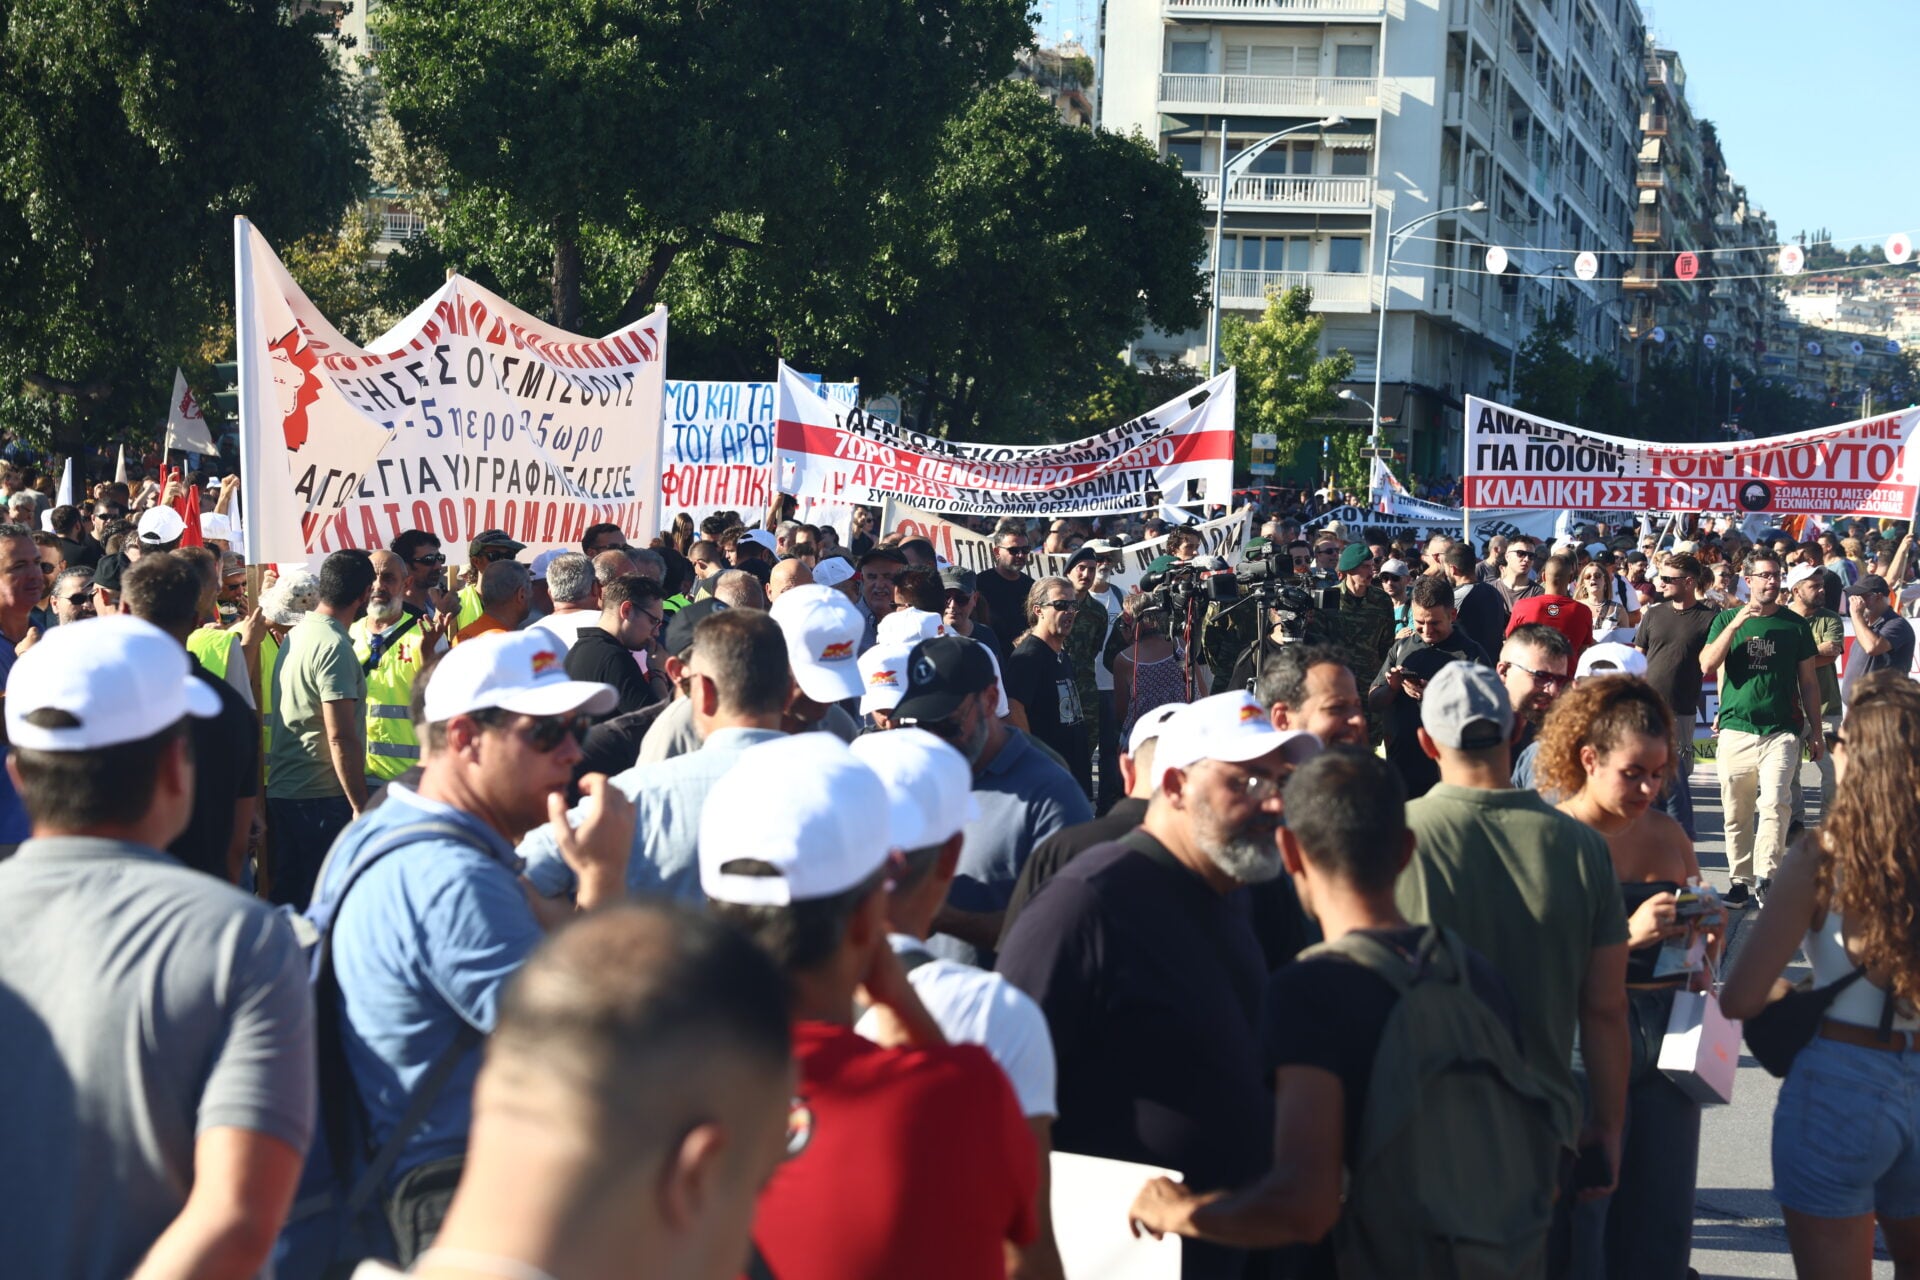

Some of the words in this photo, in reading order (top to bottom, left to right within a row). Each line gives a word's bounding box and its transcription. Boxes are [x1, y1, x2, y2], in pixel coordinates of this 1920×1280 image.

[664, 382, 699, 422] ΜΟ
[704, 383, 741, 421] ΚΑΙ
[672, 424, 714, 463] ΤΟΥ
[833, 431, 897, 469] 7ΩΡΟ
[916, 456, 1074, 490] ΠΕΝΘΗΜΕΡΟ
[1476, 444, 1518, 471] ΓΙΑ
[376, 456, 442, 497] ΓΙΑ
[850, 463, 954, 499] ΑΥΞΗΣΕΙΣ
[955, 486, 998, 505] ΣΤΑ
[999, 468, 1160, 505] ΜΕΡΟΚΑΜΑΤΑ
[1475, 479, 1594, 507] ΚΛΑΔΙΚΗ
[1600, 480, 1647, 508] ΣΣΕ
[1653, 481, 1737, 508] ΤΩΡΑ!
[1774, 486, 1838, 499] ΣΩΜΑΤΕΙΟ
[1841, 488, 1904, 501] ΜΙΣΘΩΤΩΝ
[949, 499, 1037, 514] ΟΙΚΟΔΟΜΩΝ
[1038, 493, 1142, 514] ΘΕΣΣΑΛΟΝΙΚΗΣ
[1774, 498, 1831, 510] ΤΕΧΝΙΚΩΝ
[1833, 499, 1904, 514] ΜΑΚΕΔΟΝΙΑΣ
